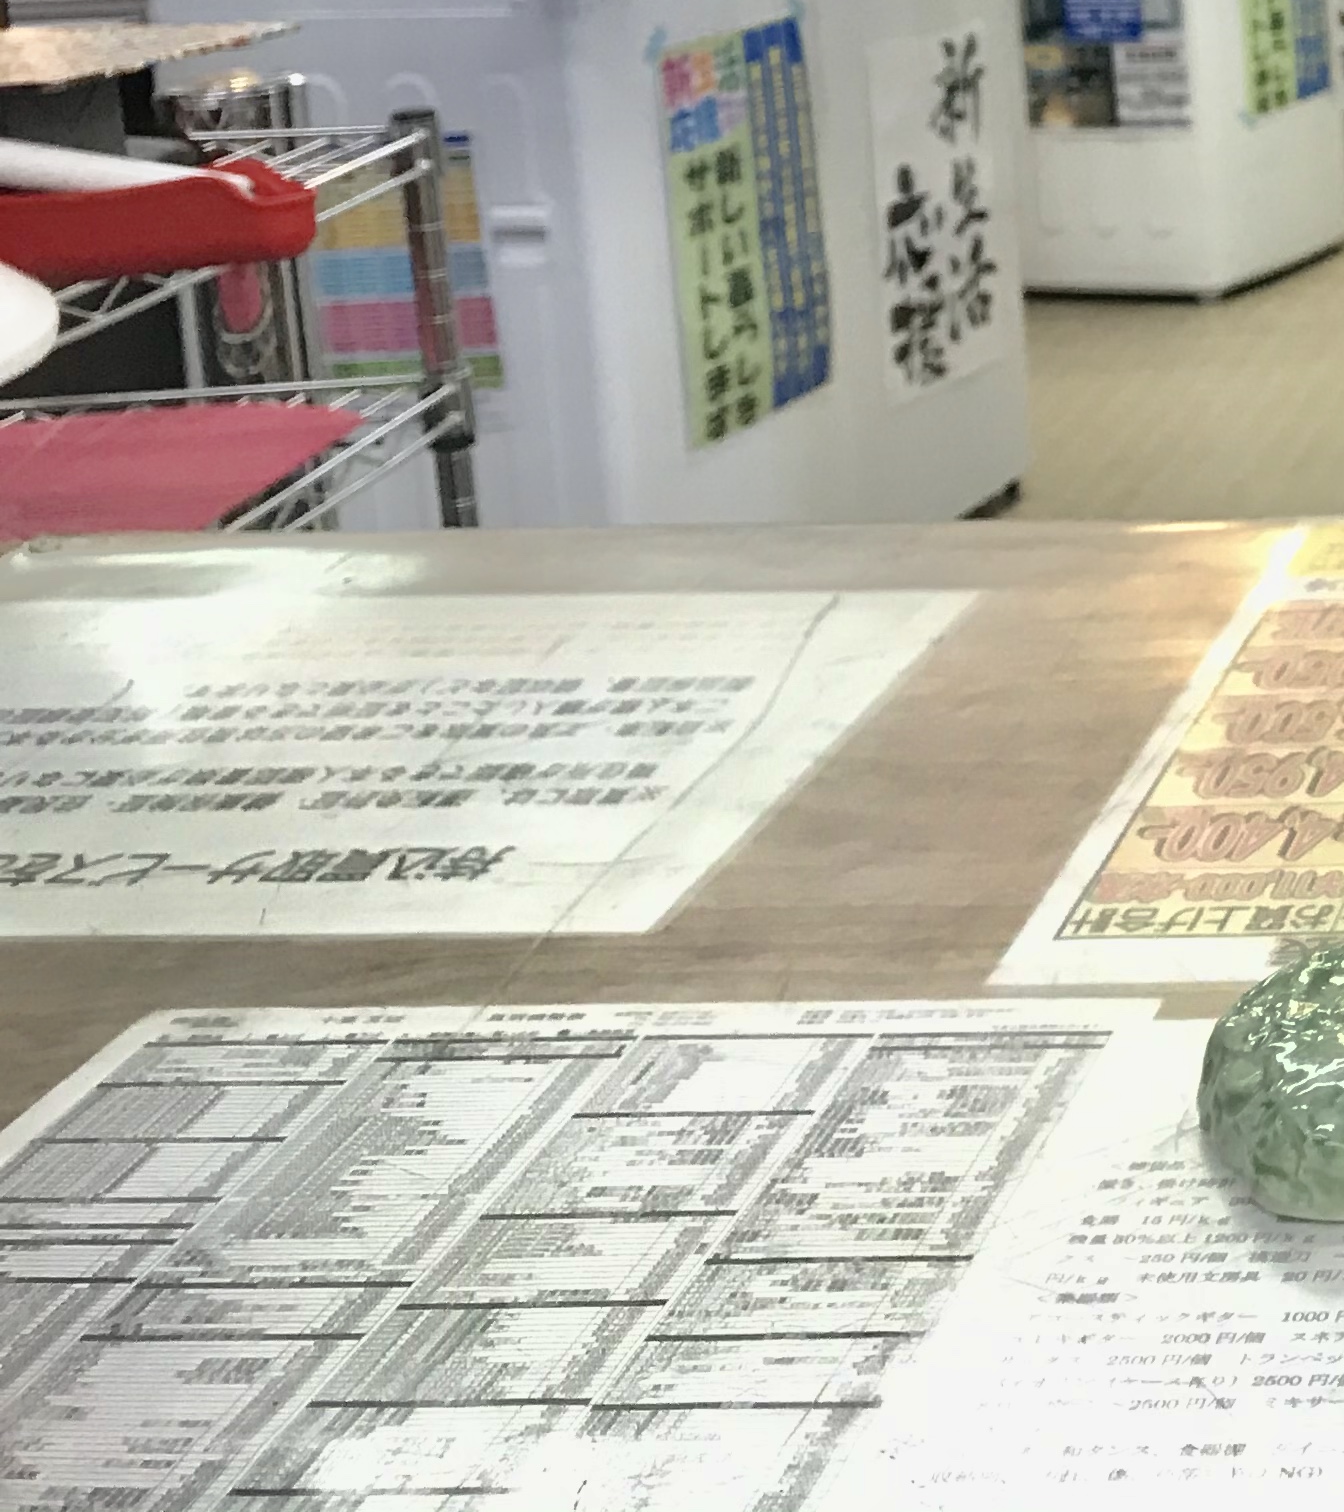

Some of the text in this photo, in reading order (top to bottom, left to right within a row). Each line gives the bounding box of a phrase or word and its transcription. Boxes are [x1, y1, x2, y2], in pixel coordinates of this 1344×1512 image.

[1067, 902, 1337, 935] お買上げ合計
